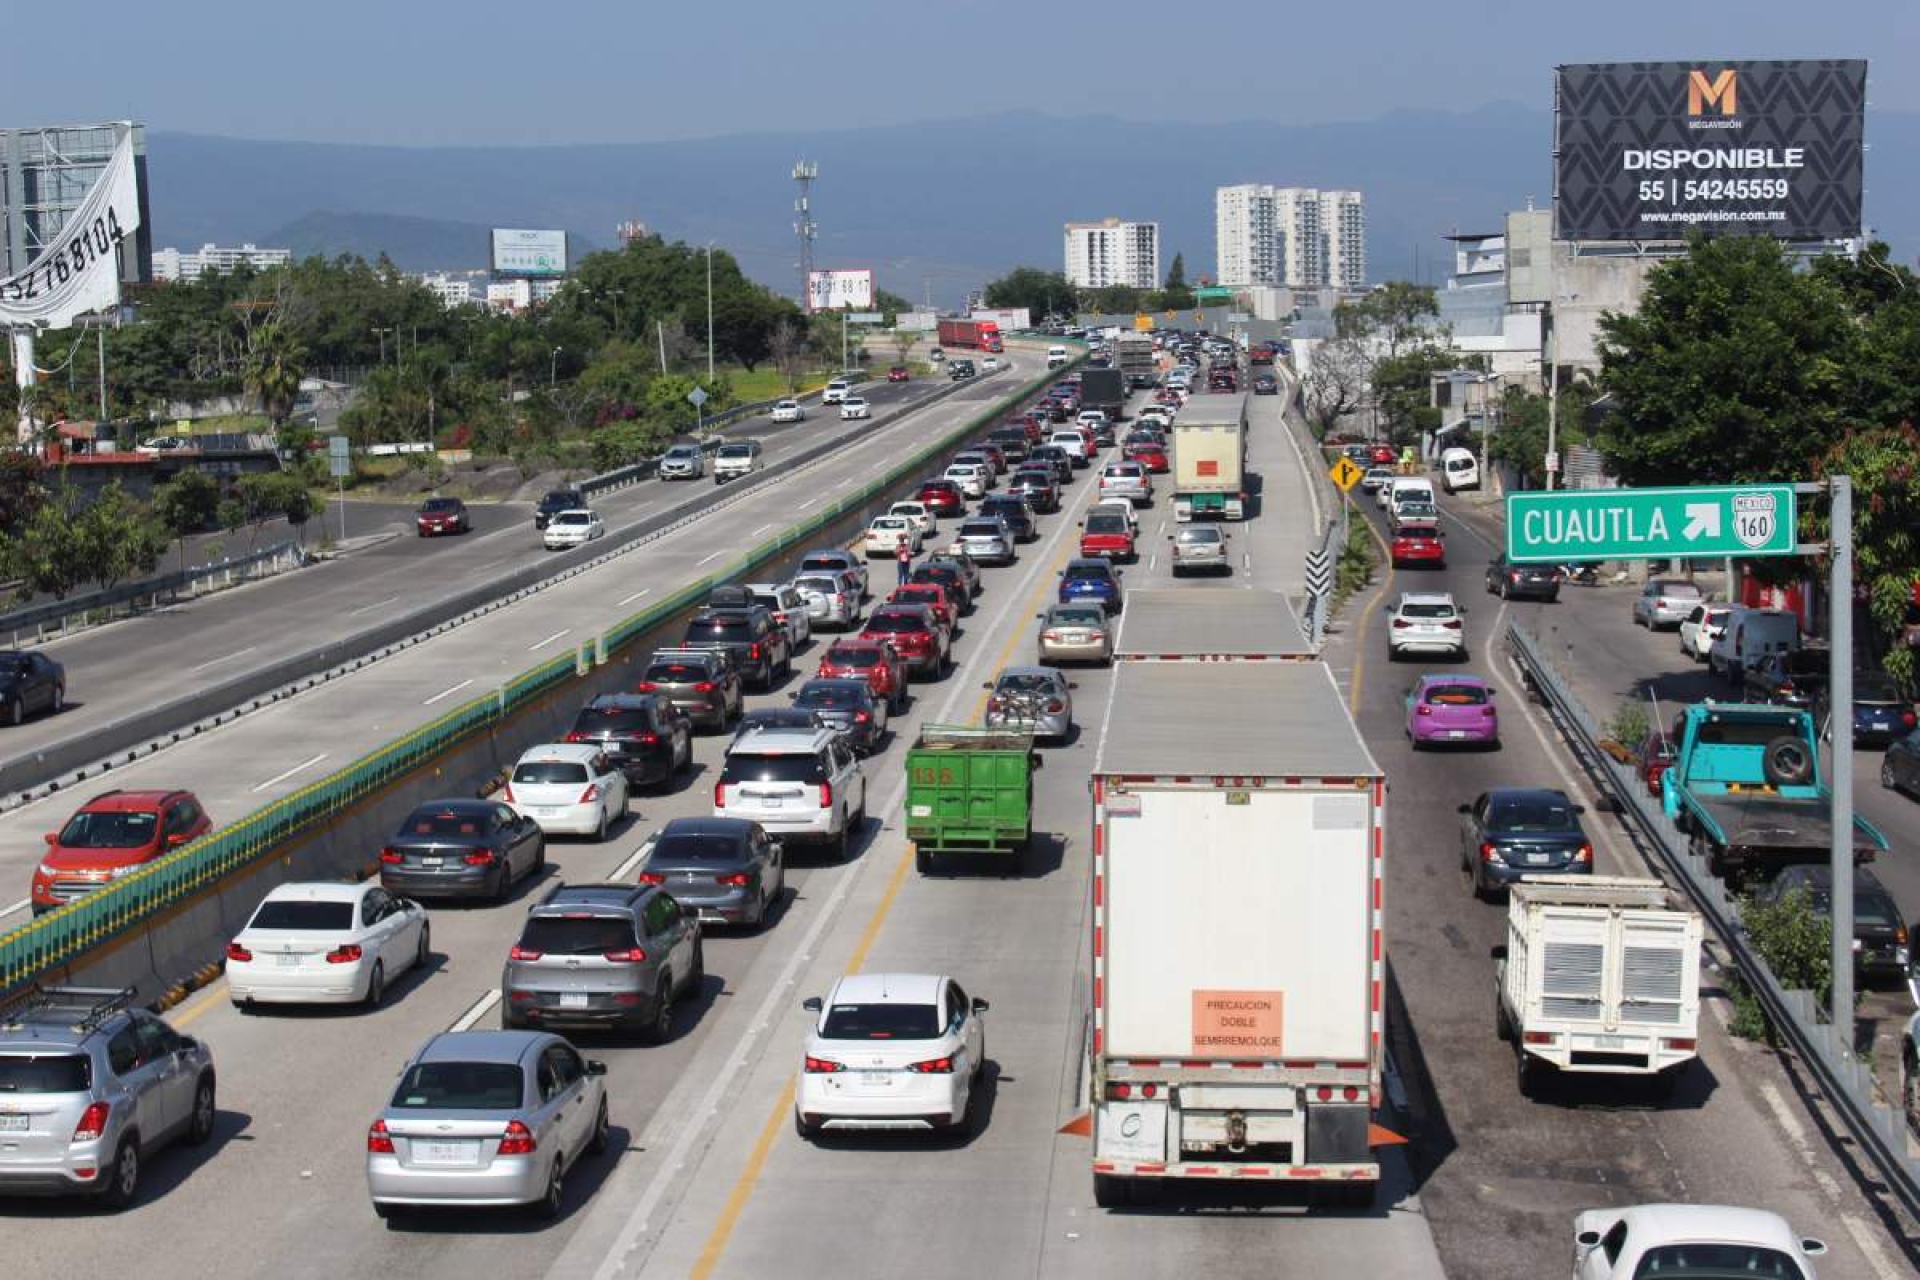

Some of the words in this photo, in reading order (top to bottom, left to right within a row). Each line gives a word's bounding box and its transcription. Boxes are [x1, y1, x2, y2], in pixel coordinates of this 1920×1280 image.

[1688, 69, 1737, 116] M
[1623, 148, 1805, 171] DISPONIBLE
[1638, 180, 1665, 201] 55
[1684, 178, 1788, 200] 54245559
[1641, 209, 1787, 224] www.megavision.com.mx
[1736, 498, 1772, 509] MEXICO
[1524, 506, 1670, 545] CUAUTLA
[1740, 516, 1768, 537] 160
[1206, 1000, 1271, 1011] PRECAUCION
[1220, 1016, 1256, 1028] DOBLE
